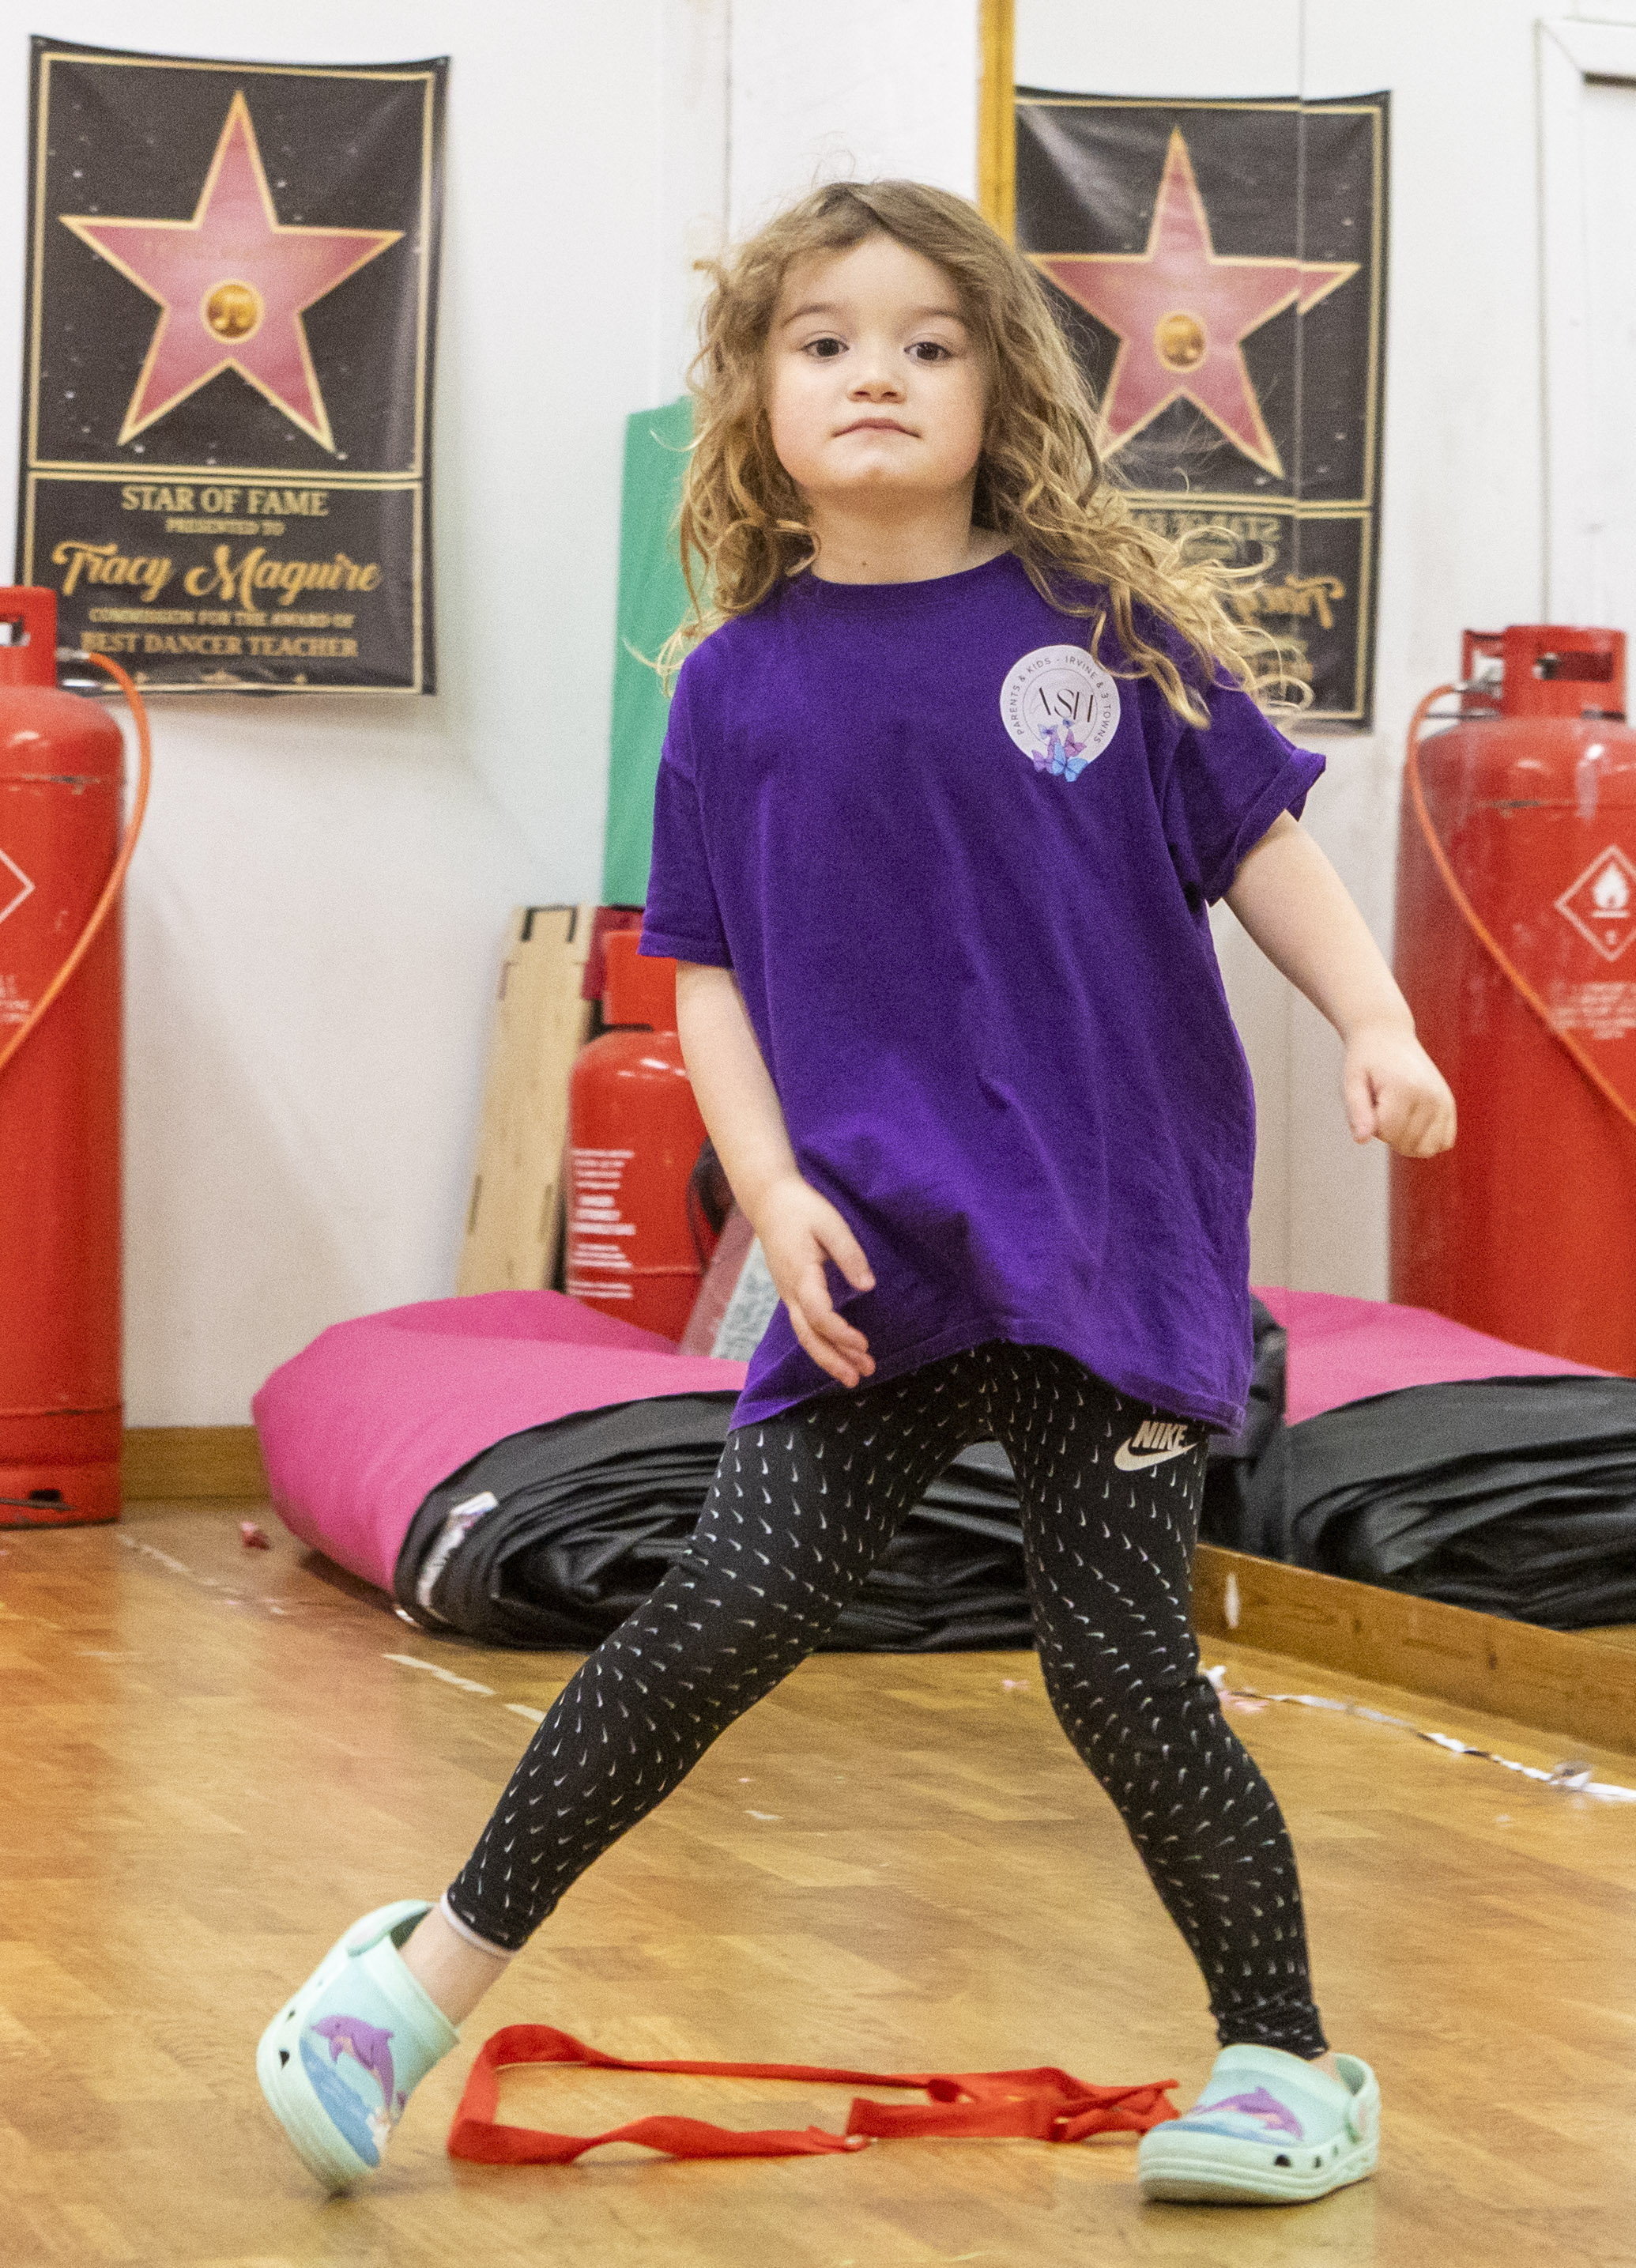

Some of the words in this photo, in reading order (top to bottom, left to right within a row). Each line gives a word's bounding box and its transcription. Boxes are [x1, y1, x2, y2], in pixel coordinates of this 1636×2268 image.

[121, 485, 195, 512] STAR
[199, 487, 240, 514] OF
[247, 489, 330, 516] FAME
[51, 542, 172, 603] Tracy
[183, 545, 381, 612] Maguire
[81, 632, 138, 654] BEST
[144, 633, 241, 656] DANCER
[247, 636, 358, 658] TEACHER
[1009, 685, 1025, 735] PARENTS
[1027, 657, 1052, 674] KIDS
[1065, 655, 1097, 680] IRVINE
[1093, 704, 1112, 744] TOWNS
[1131, 1420, 1189, 1451] NIKE
